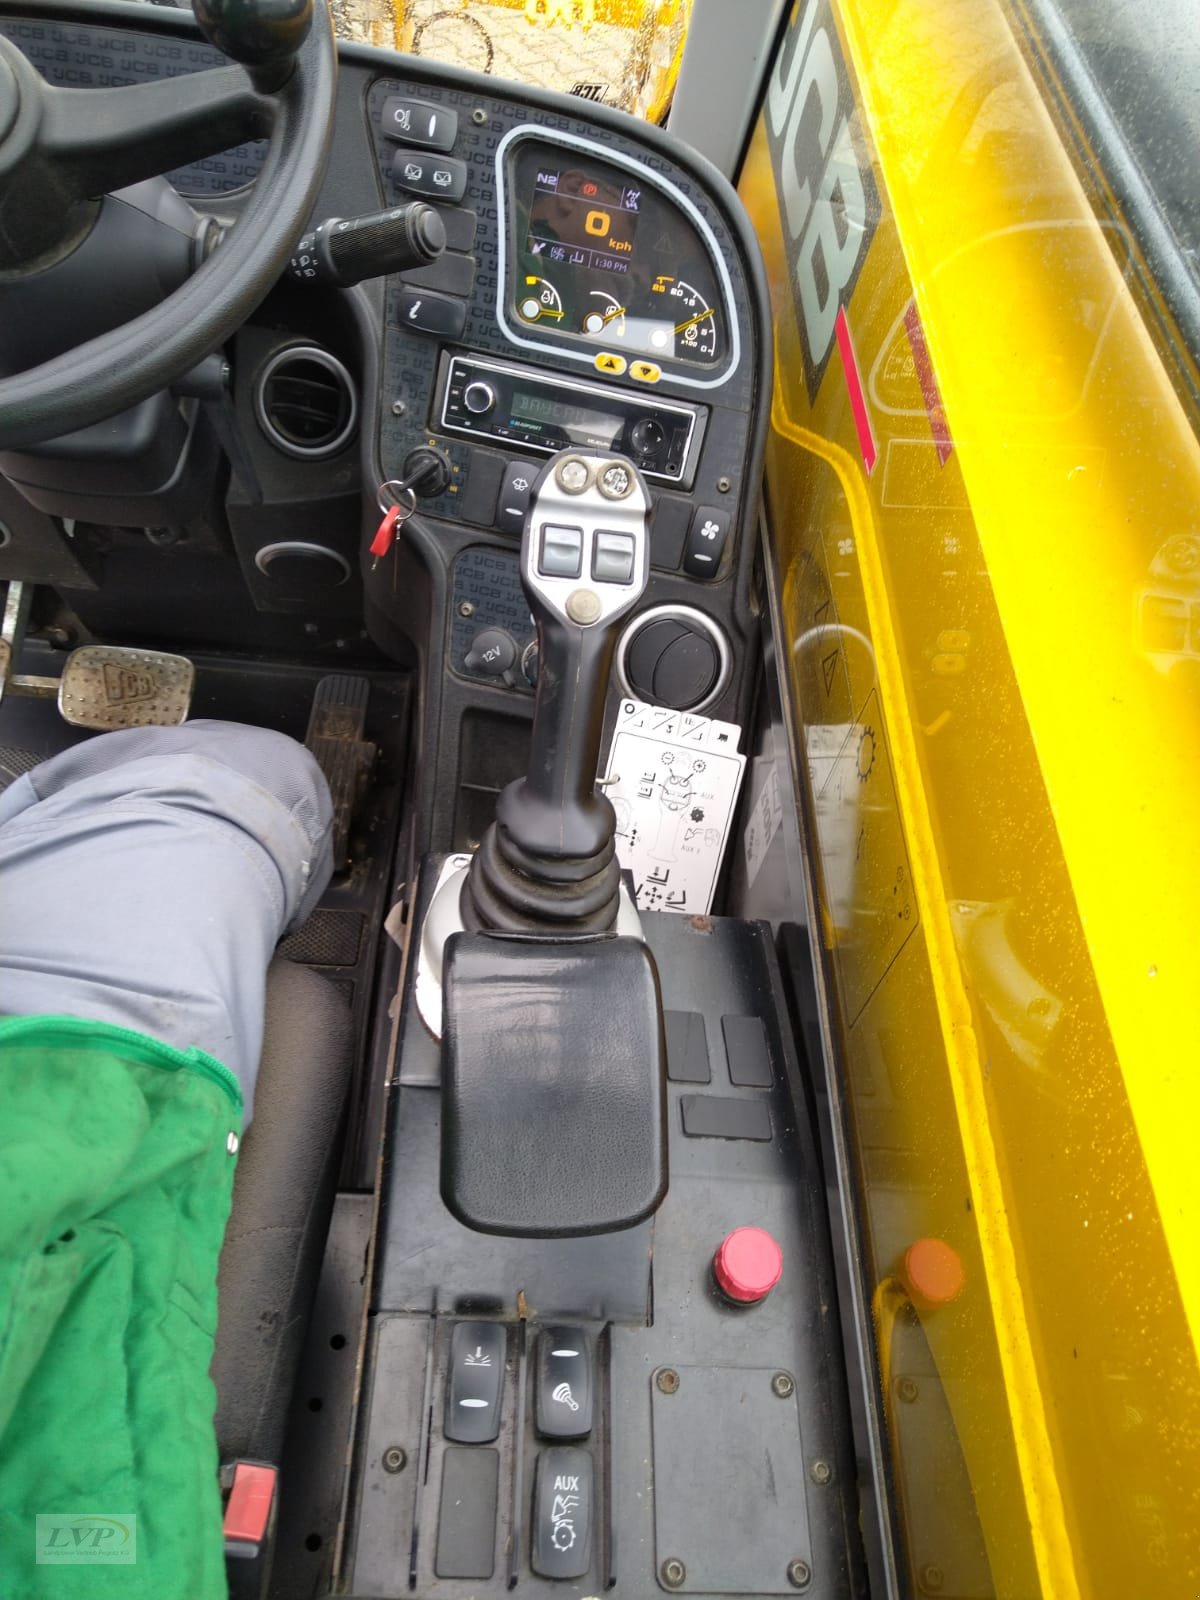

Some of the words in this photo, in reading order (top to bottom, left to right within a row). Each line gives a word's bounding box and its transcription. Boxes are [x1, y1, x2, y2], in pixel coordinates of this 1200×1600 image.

[98, 37, 136, 53] JCB
[143, 44, 182, 59] JCB
[188, 50, 226, 66] JCB
[30, 46, 68, 62] JCB
[75, 52, 113, 69] JCB
[120, 59, 158, 75] JCB
[53, 66, 92, 83] JCB
[492, 103, 528, 120] JCB
[534, 113, 570, 130] JCB
[233, 163, 257, 177] JC
[537, 173, 557, 186] N2
[768, 0, 866, 366] JCB
[584, 210, 611, 237] 0
[608, 237, 632, 251] kph
[595, 257, 611, 269] 1:30
[613, 261, 628, 273] PM
[474, 555, 507, 571] JCB
[469, 583, 501, 599] JCB
[485, 602, 518, 617] JCB
[482, 645, 501, 663] 12V
[553, 1475, 580, 1492] AUX
